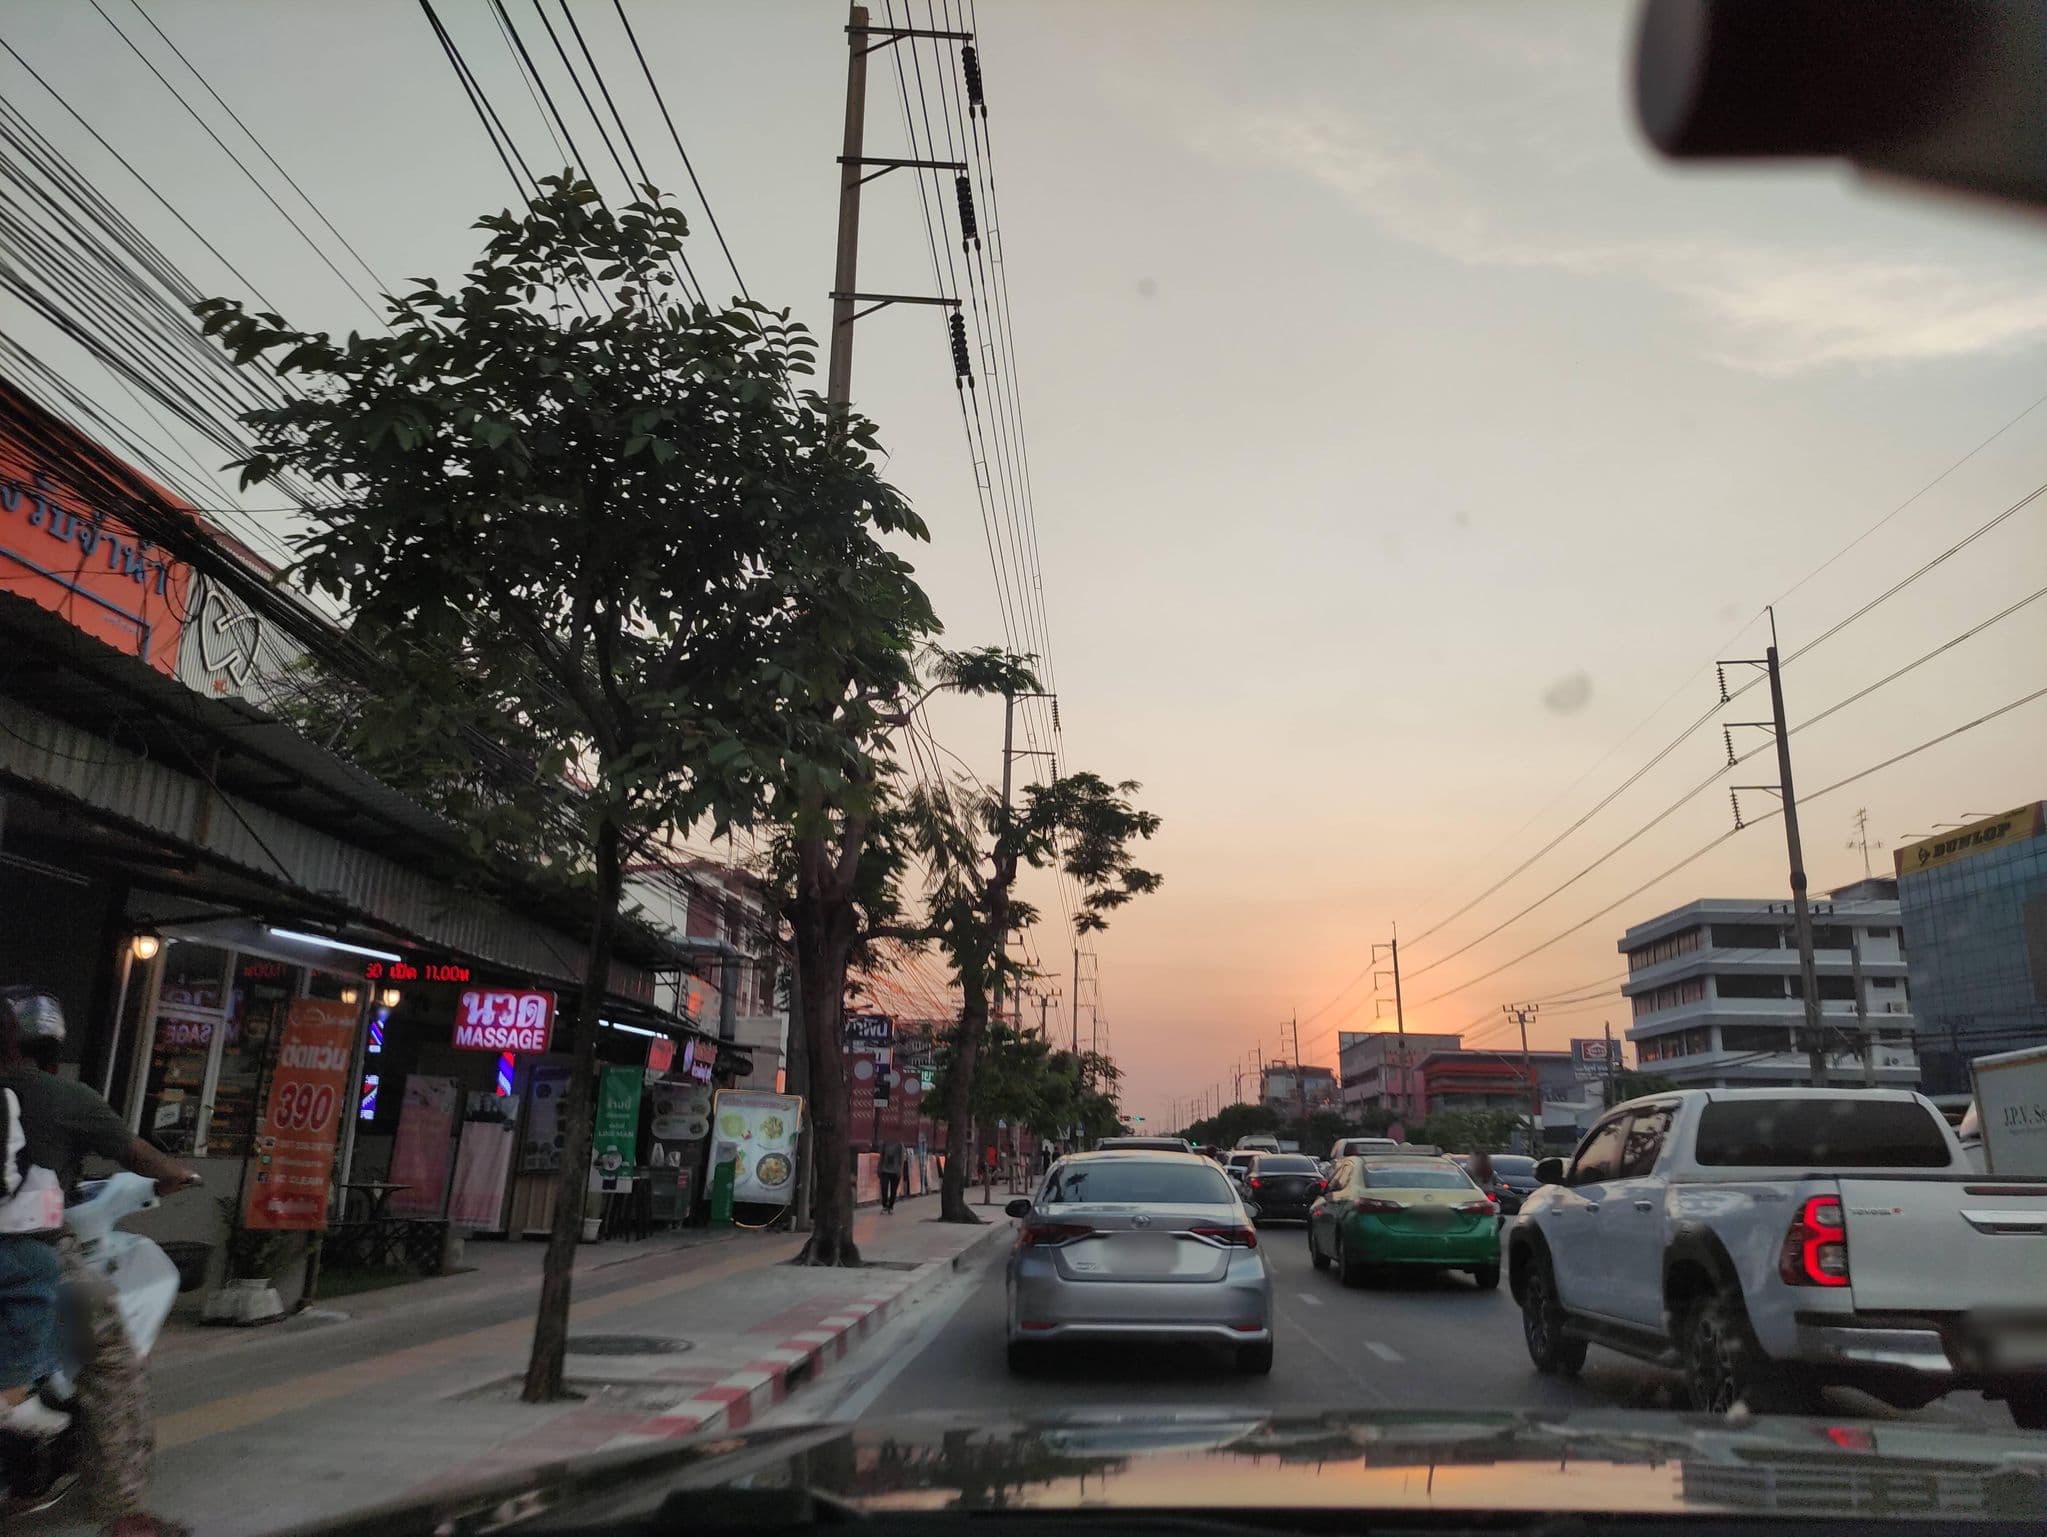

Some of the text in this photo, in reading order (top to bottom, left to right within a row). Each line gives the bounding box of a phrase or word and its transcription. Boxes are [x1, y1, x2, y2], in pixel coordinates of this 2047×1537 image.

[1933, 821, 2011, 858] DUNLOP
[462, 991, 548, 1029] นวด
[455, 1025, 545, 1050] MASSAGE
[274, 1080, 336, 1132] 390
